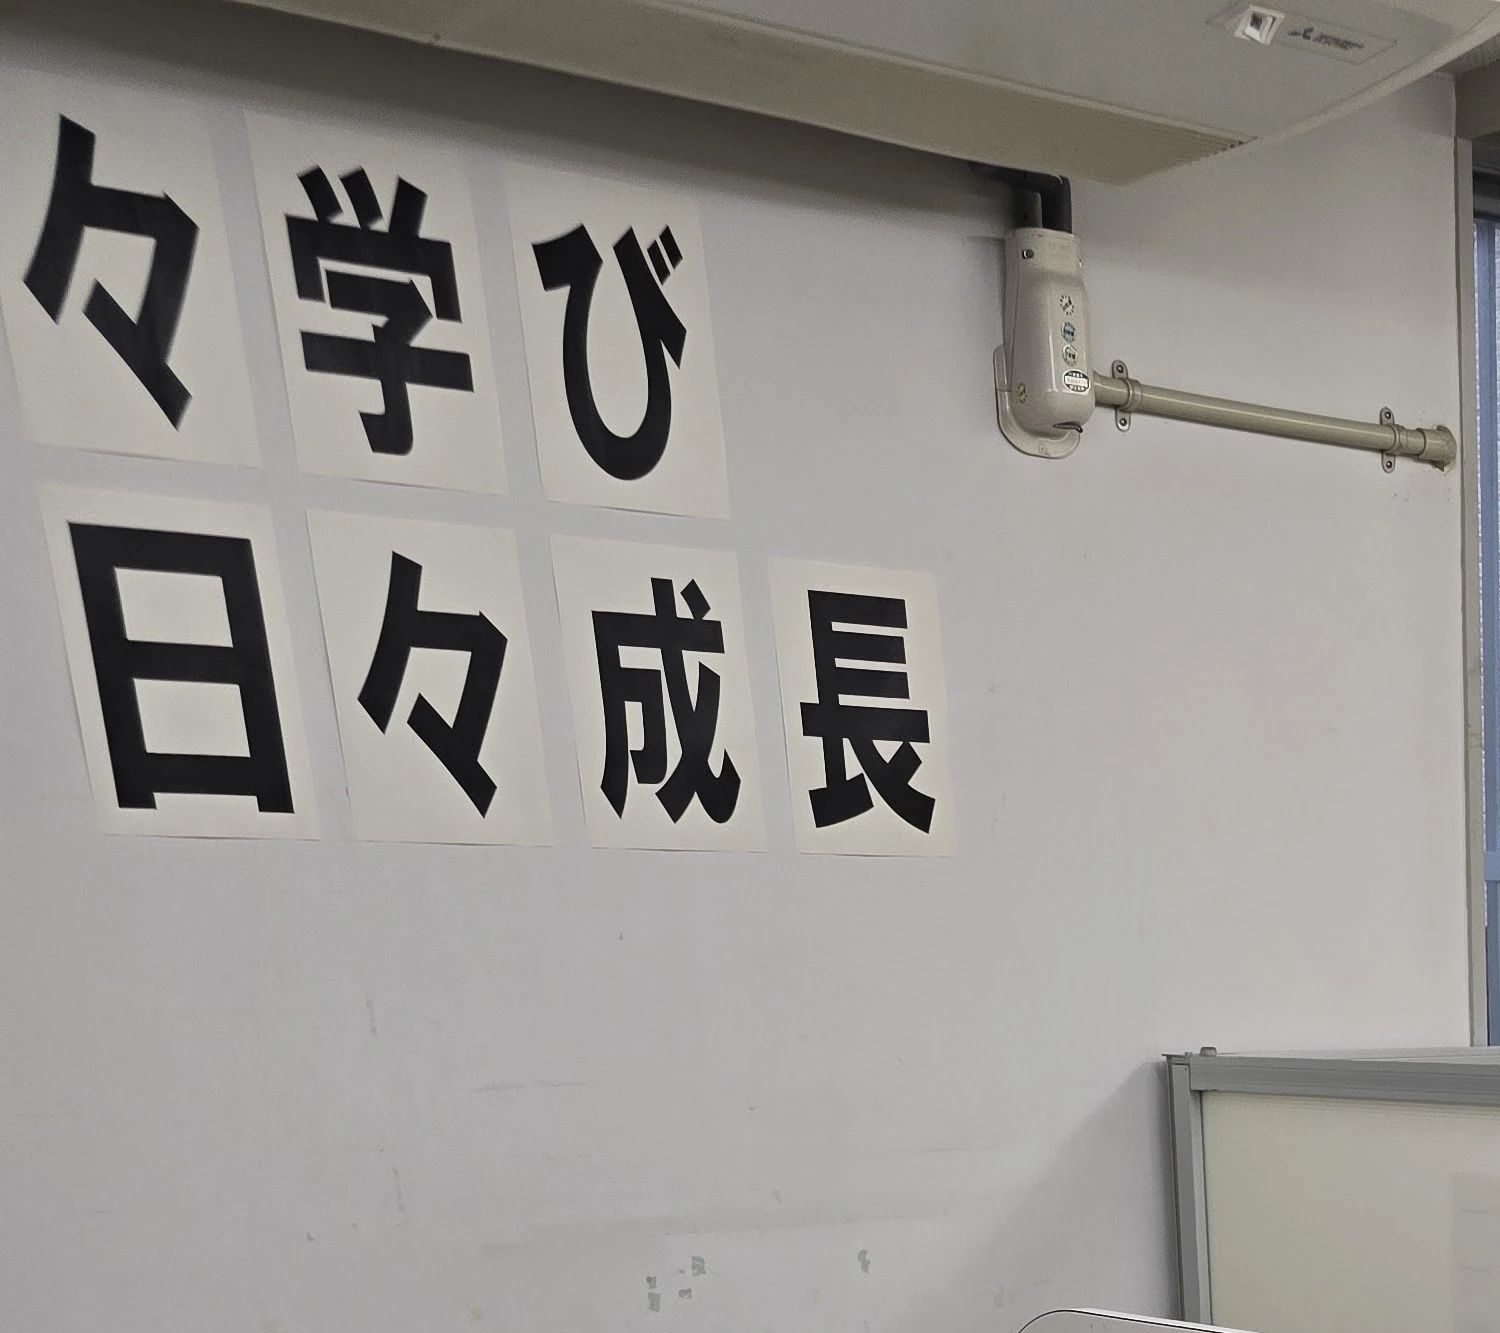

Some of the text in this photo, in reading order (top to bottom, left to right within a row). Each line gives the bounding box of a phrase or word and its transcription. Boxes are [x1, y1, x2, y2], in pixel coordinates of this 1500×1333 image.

[23, 114, 688, 480] 々学び
[68, 521, 936, 835] 日々成長
